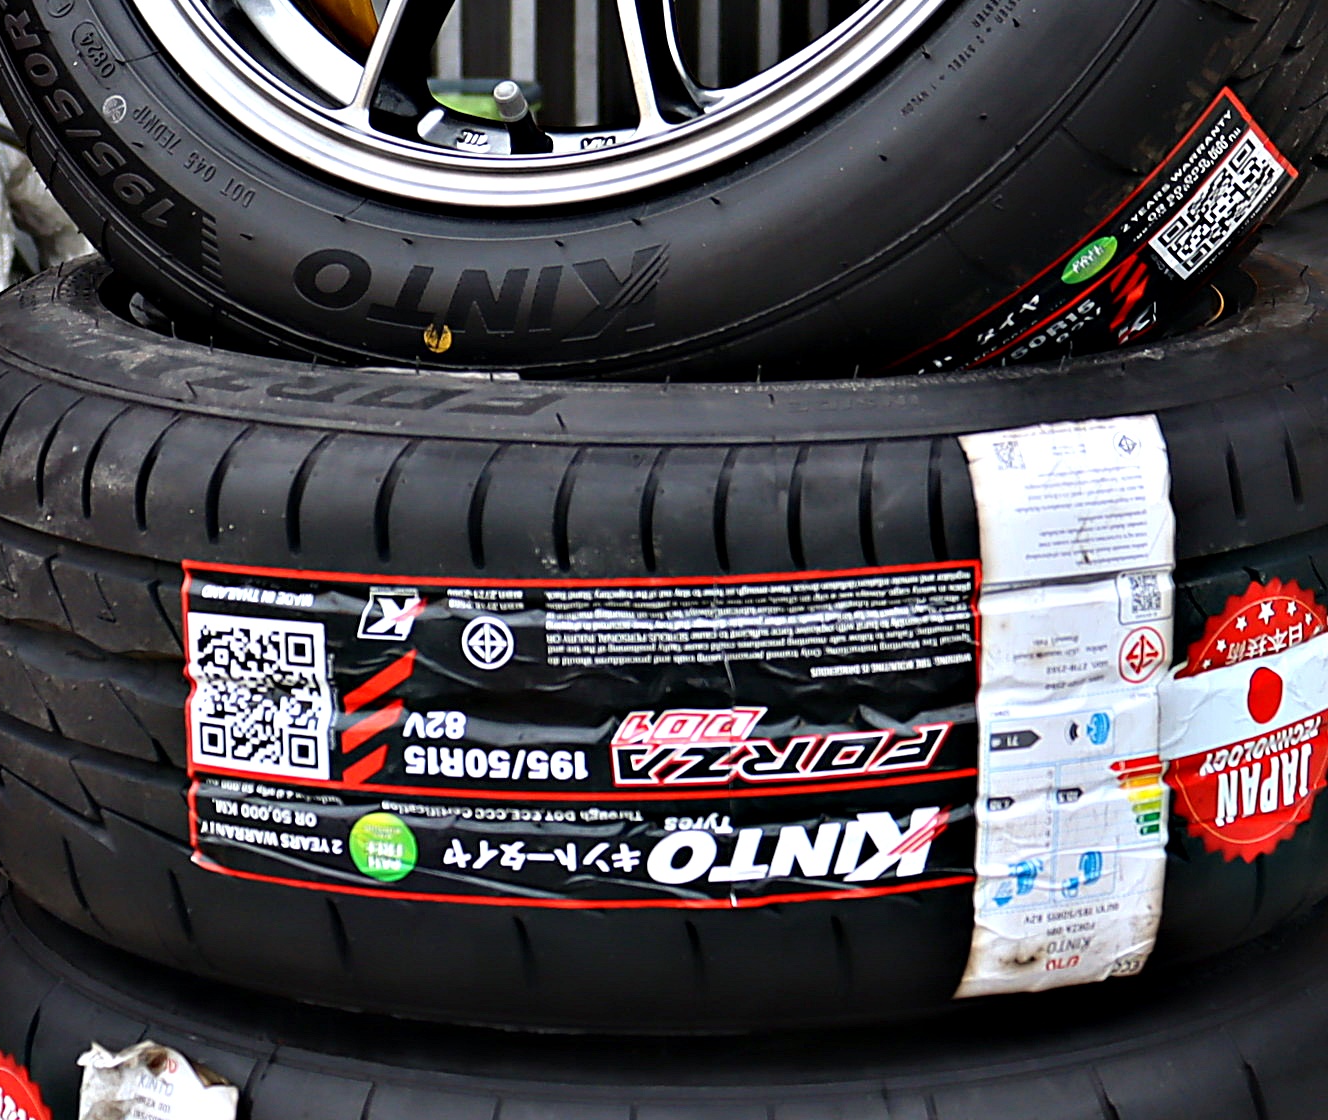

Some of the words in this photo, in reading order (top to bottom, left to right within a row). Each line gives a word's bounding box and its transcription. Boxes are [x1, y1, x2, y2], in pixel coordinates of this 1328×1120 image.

[1130, 182, 1171, 227] YEARS
[1171, 109, 1233, 183] WARRANTY
[217, 175, 257, 209] DOT
[292, 243, 672, 343] KINTO
[200, 583, 259, 604] THAILAND
[260, 590, 276, 605] IN
[278, 591, 314, 608] MADE
[1224, 623, 1304, 665] 日本技術
[402, 709, 467, 740] 82V
[609, 705, 768, 748] 001
[609, 720, 954, 788] FORZA
[1198, 714, 1323, 777] TECHNOLOGY
[402, 745, 589, 780] 195/50R15
[1215, 742, 1313, 827] JAPAN
[212, 798, 239, 819] KM.
[241, 801, 292, 825] 50,000
[294, 810, 318, 828] OR
[664, 813, 733, 834] Tyres
[198, 819, 278, 848] WARRANTY
[279, 831, 330, 853] YEARS
[331, 839, 344, 855] 2
[646, 805, 951, 885] KINTO
[442, 836, 641, 874] キントータイヤ
[1045, 935, 1093, 953] KINTO
